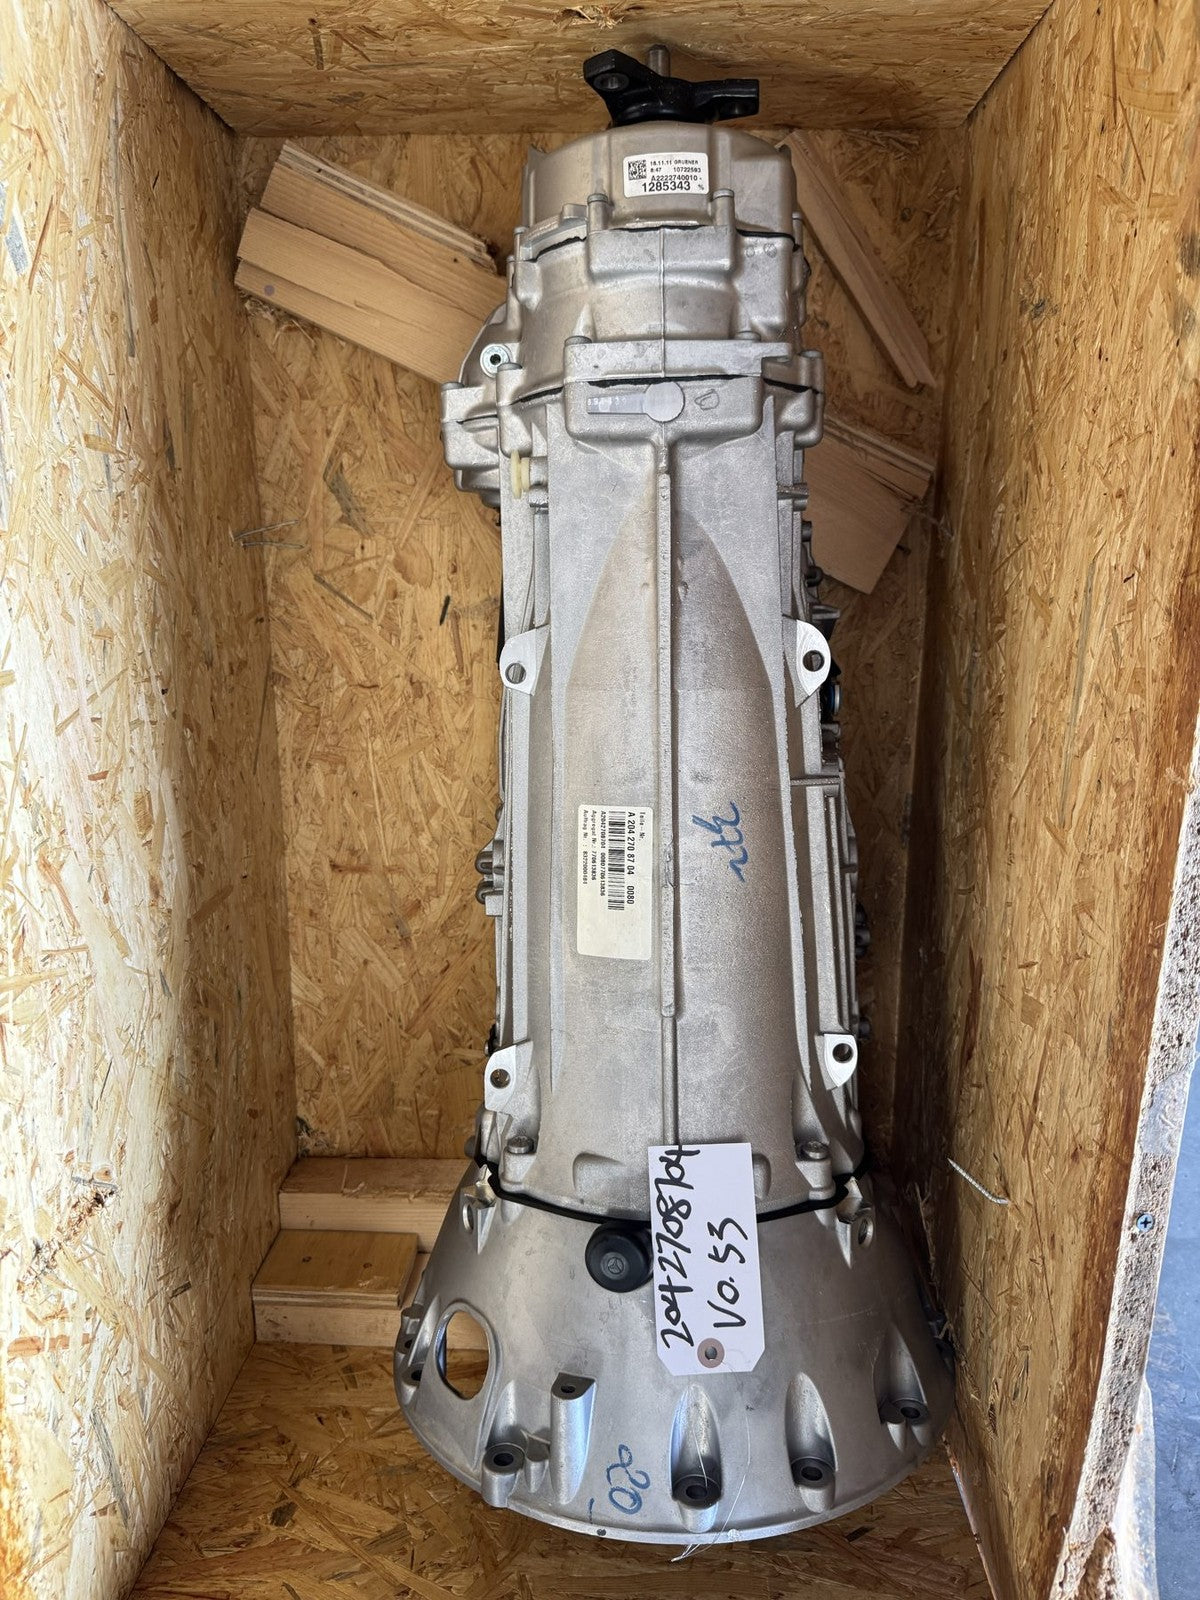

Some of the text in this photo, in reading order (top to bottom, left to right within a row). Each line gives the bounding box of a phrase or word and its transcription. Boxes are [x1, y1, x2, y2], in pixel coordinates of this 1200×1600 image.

[651, 174, 698, 182] A2222740010
[642, 180, 691, 192] 1285343
[627, 837, 635, 851] 270
[627, 854, 635, 863] 87
[627, 866, 635, 875] 04
[654, 1144, 701, 1350] 2042708704
